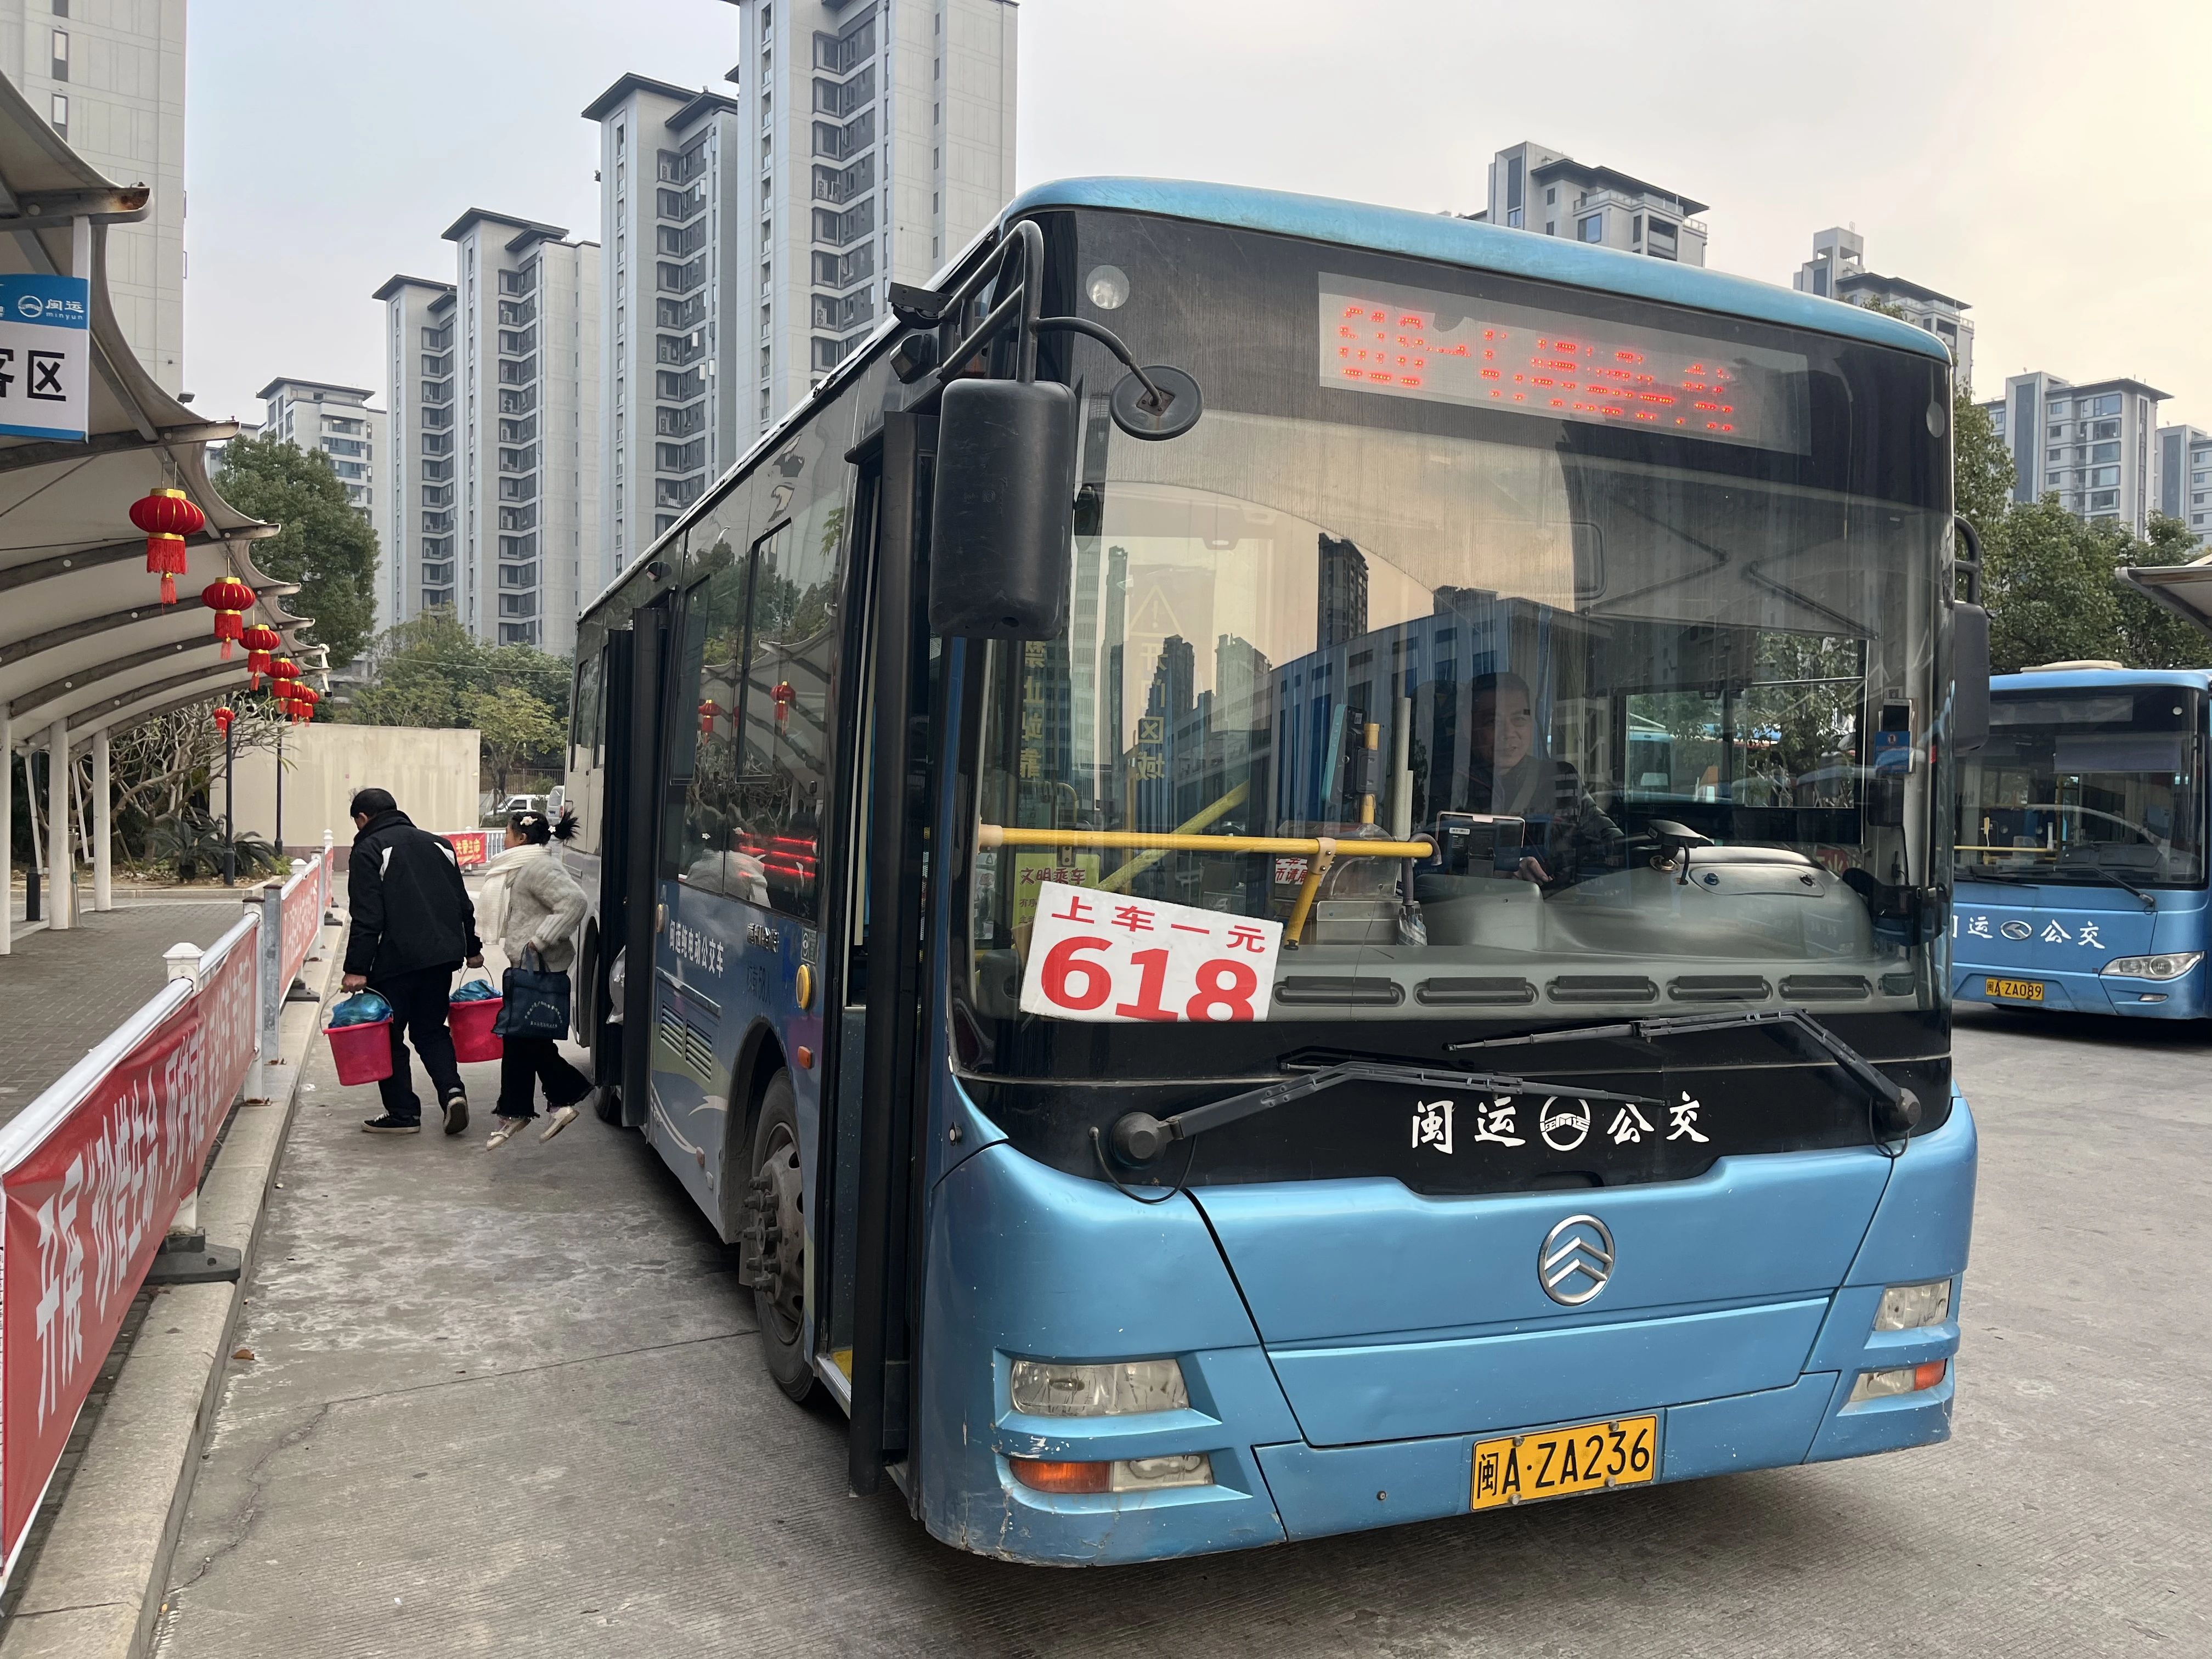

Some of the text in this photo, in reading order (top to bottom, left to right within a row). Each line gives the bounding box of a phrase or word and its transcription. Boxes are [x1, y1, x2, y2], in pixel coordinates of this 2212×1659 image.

[1019, 867, 1086, 885] 文明乘车
[1051, 895, 1265, 954] 上车一元
[1953, 915, 1993, 939] 运
[1041, 935, 1257, 1022] 618
[1412, 1091, 1710, 1154] 闽运 公交
[1476, 1428, 1651, 1499] 闽A·ZA236
